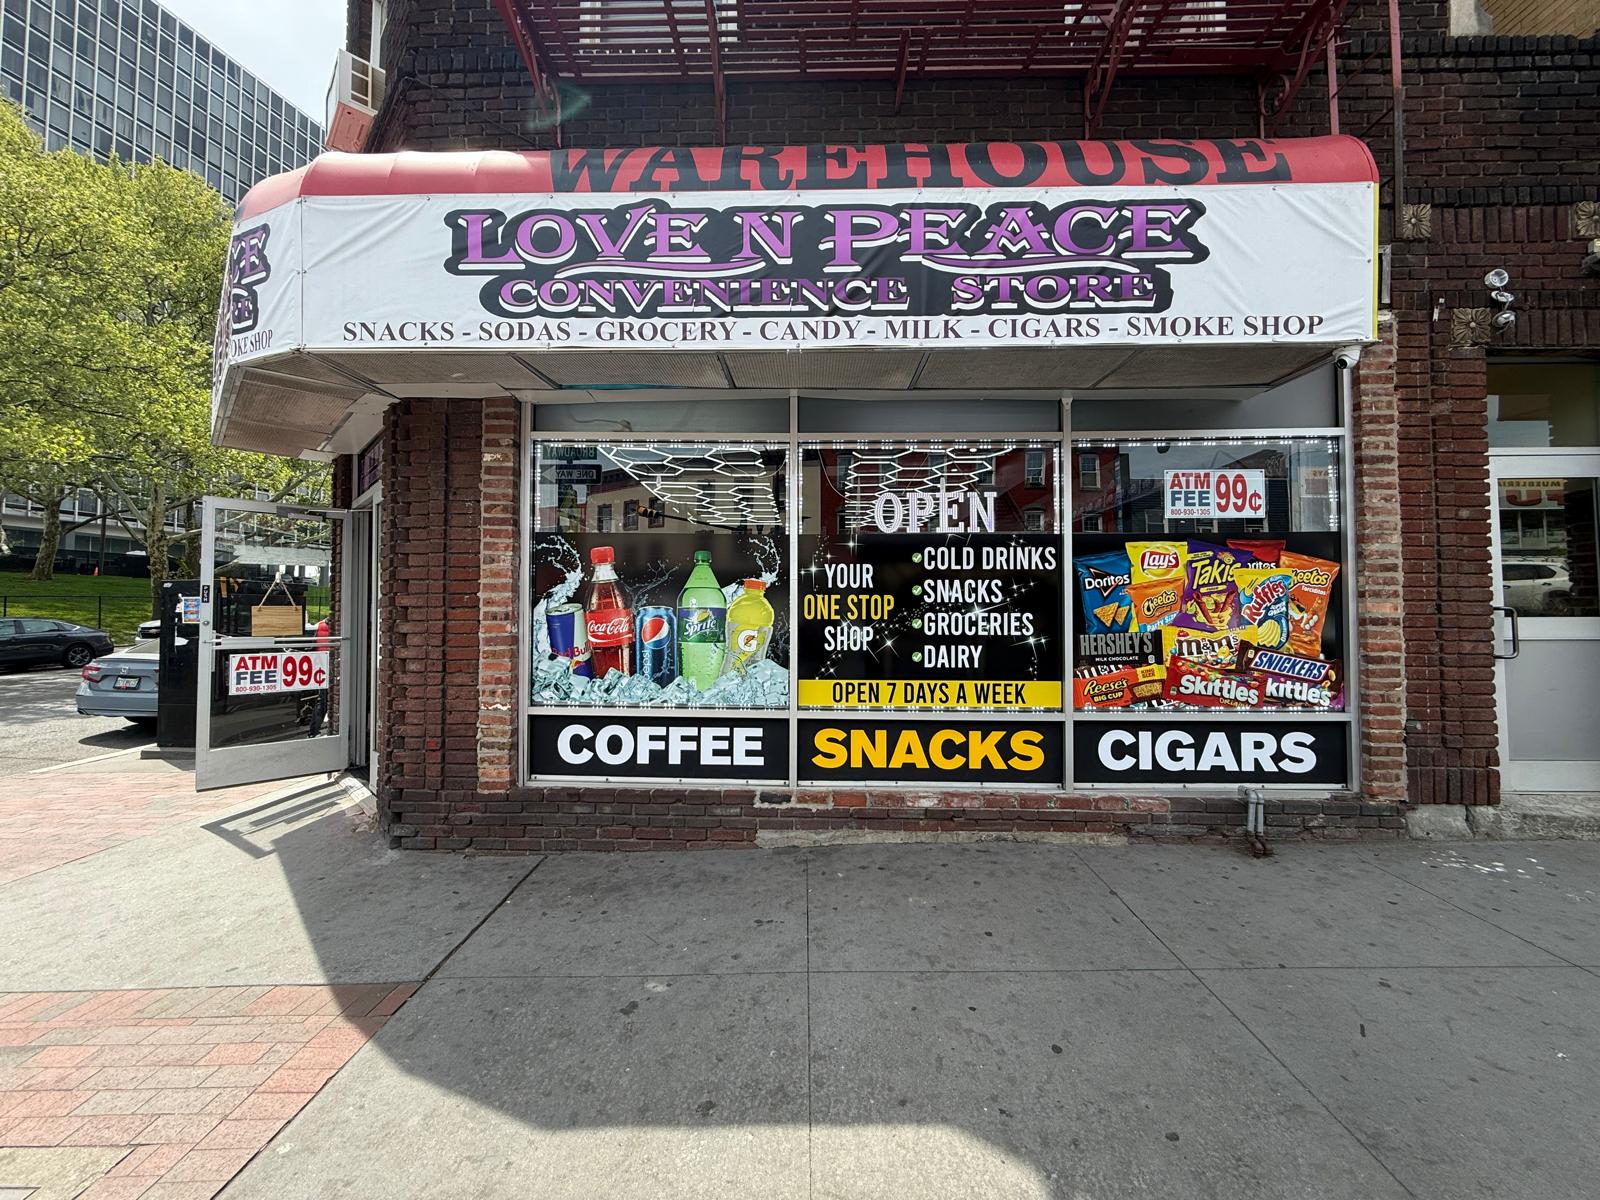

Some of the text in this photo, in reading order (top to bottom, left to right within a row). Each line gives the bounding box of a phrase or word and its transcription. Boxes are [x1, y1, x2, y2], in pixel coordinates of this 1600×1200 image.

[550, 139, 1292, 192] WAREHOUSE
[457, 203, 1195, 273] LOVE N PEACE
[498, 273, 1157, 313] CONVENIENCE STORE
[343, 321, 455, 342] SNACKS
[478, 321, 571, 342] SODAS
[595, 320, 736, 342] GROCERY
[759, 319, 861, 341] CANDY
[885, 318, 963, 340] MILK
[988, 317, 1100, 339] CIGARS
[1127, 315, 1234, 337] SMOKE
[1243, 315, 1324, 336] SHOP
[250, 329, 273, 354] SHOP
[1169, 473, 1211, 490] ATM
[1170, 490, 1211, 507] FEE
[874, 491, 997, 534] OPEN
[1170, 508, 1211, 516] 800-930-1305
[924, 547, 1057, 570] COLD DRINKS
[1143, 550, 1177, 569] Lay's
[1246, 561, 1277, 569] ritos
[824, 564, 874, 588] YOUR
[1084, 574, 1130, 590] Doritos
[1291, 569, 1329, 586] heetos
[924, 579, 1003, 603] SNACKS
[1243, 581, 1285, 624] Ruffles
[803, 595, 895, 620] ONE STOP
[1143, 591, 1176, 616] Cheetos
[587, 617, 630, 635] Coca-Cola
[684, 619, 717, 636] Sprite
[924, 613, 1034, 636] GROCERIES
[824, 627, 874, 651] SHOP
[1079, 632, 1153, 656] HERSHEY'S
[235, 656, 278, 671] ATM
[924, 645, 983, 668] DAIRY
[1252, 652, 1328, 680] SNICKERS
[235, 670, 277, 686] FEE
[1083, 679, 1128, 696] Reese's
[1179, 674, 1259, 705] Skittles
[832, 682, 1026, 704] OPEN 7 DAYS A WEEK
[1093, 691, 1123, 704] BIG CUP
[1265, 677, 1331, 707] kittles
[557, 724, 765, 766] COFFEE
[811, 728, 1045, 771] SNACKS
[1097, 729, 1317, 774] CIGARS
